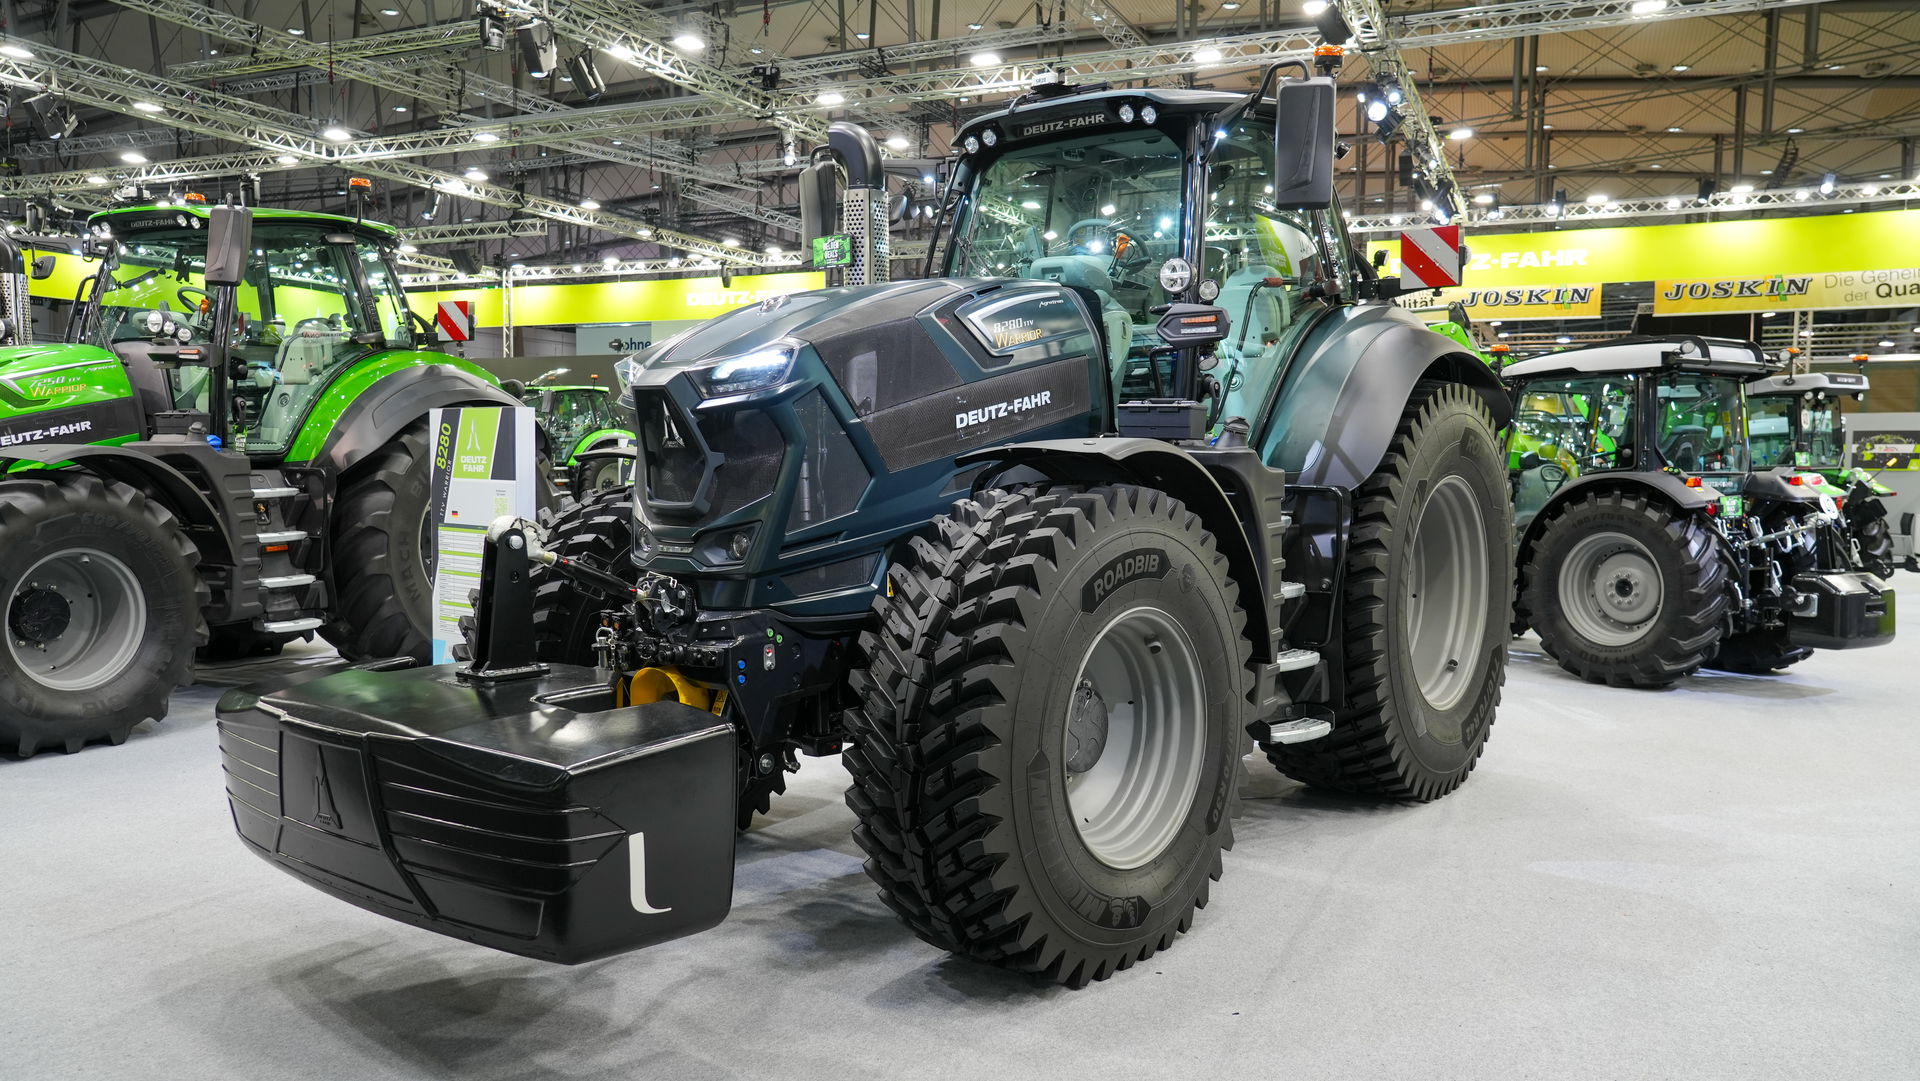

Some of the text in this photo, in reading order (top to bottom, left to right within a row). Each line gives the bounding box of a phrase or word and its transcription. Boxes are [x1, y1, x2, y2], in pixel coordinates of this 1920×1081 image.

[1023, 114, 1105, 136] DEUTZ-FAHR
[1663, 277, 1813, 301] JOSKIN
[1824, 274, 1854, 289] Die
[1844, 282, 1920, 303] der Qua
[1461, 287, 1595, 308] JOSKIN
[993, 318, 1023, 334] 8280
[955, 390, 1051, 429] DEUTZ-FAHR
[0, 420, 92, 447] EUTZ-FAHR
[436, 423, 451, 470] 8280
[460, 455, 487, 464] DEUTZ
[463, 464, 485, 473] FAHR
[443, 459, 453, 498] WARRIOR
[1093, 554, 1160, 603] ROADBIB
